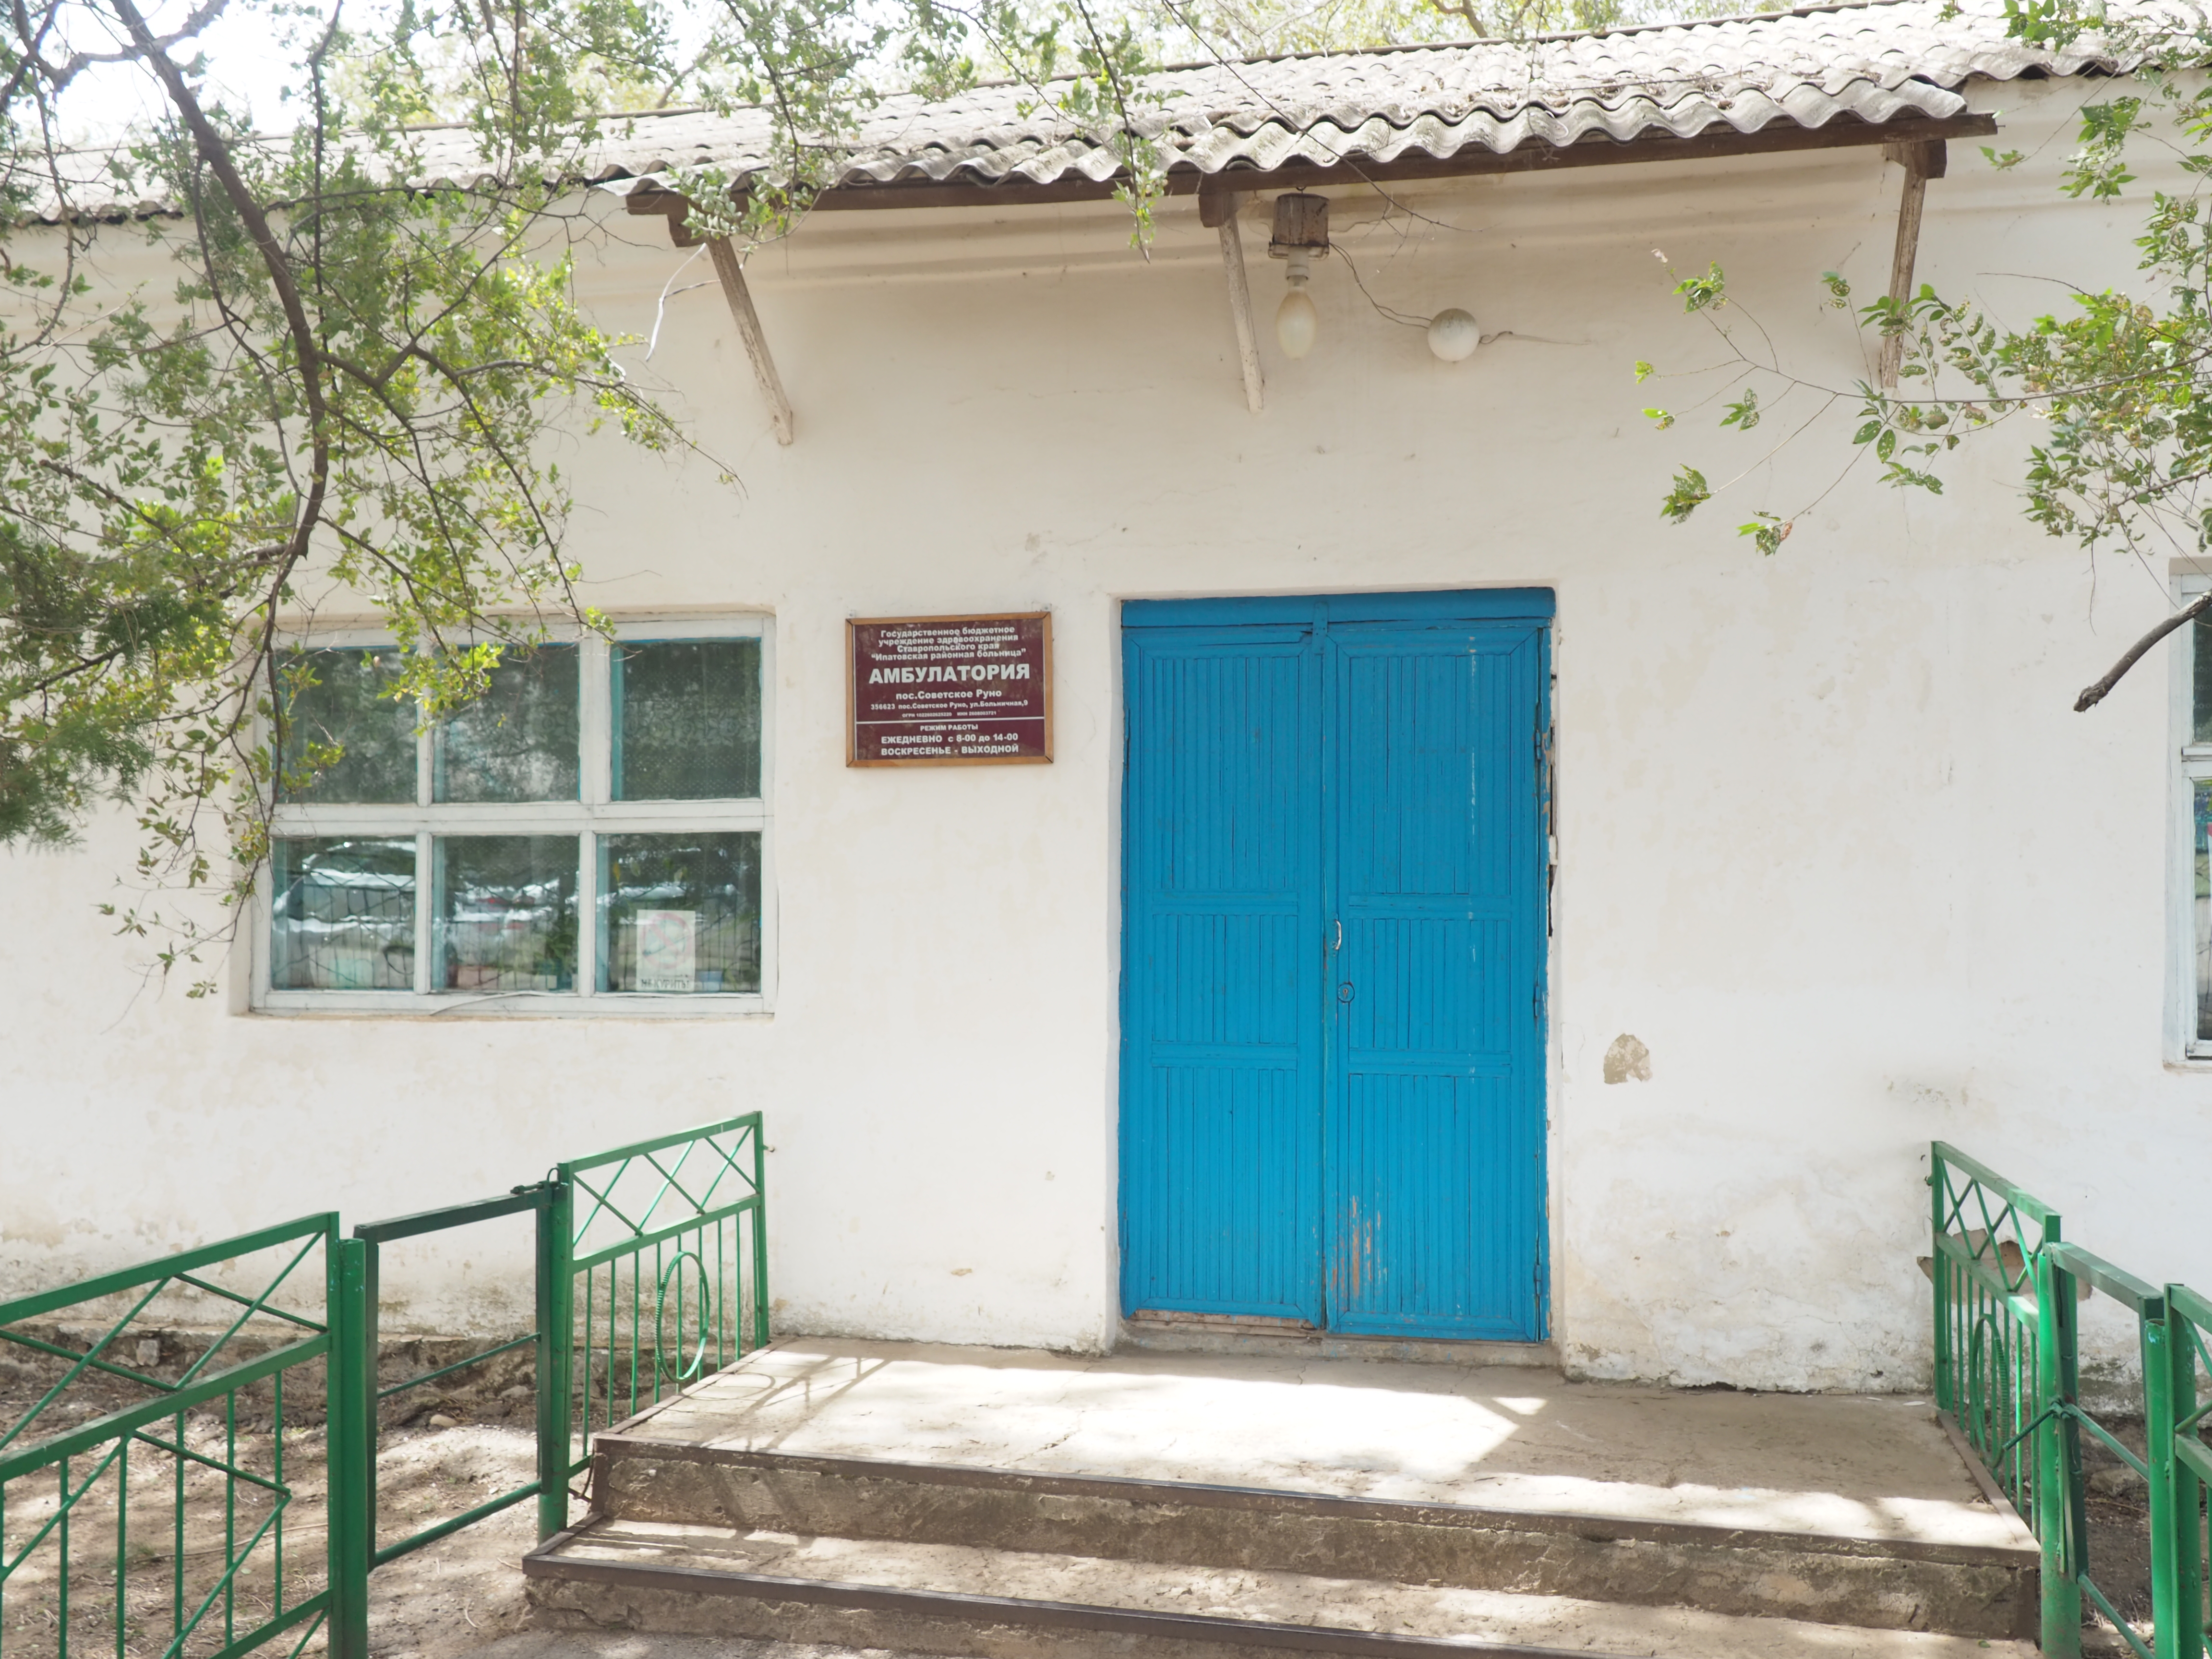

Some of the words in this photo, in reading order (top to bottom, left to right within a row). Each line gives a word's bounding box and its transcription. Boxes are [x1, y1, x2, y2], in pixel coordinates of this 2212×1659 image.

[881, 629, 960, 638] Государственное
[962, 626, 1015, 635] бюджетное
[878, 637, 935, 647] учреждение
[937, 634, 1019, 645] здравоохранения
[897, 643, 975, 653] Ставропольского
[931, 651, 974, 661] районная
[869, 663, 1030, 684] АМБУЛАТОРИЯ
[896, 691, 973, 700] пос.Советское
[976, 689, 1002, 699] Руно
[881, 735, 942, 745] ЕЖЕДНЕВНО
[956, 734, 976, 742] 8-00
[993, 733, 1018, 741] 14-00
[881, 746, 951, 756] ВОСКРЕСЕНЬЕ
[962, 744, 1019, 755] ВЫХОДНОЙ
